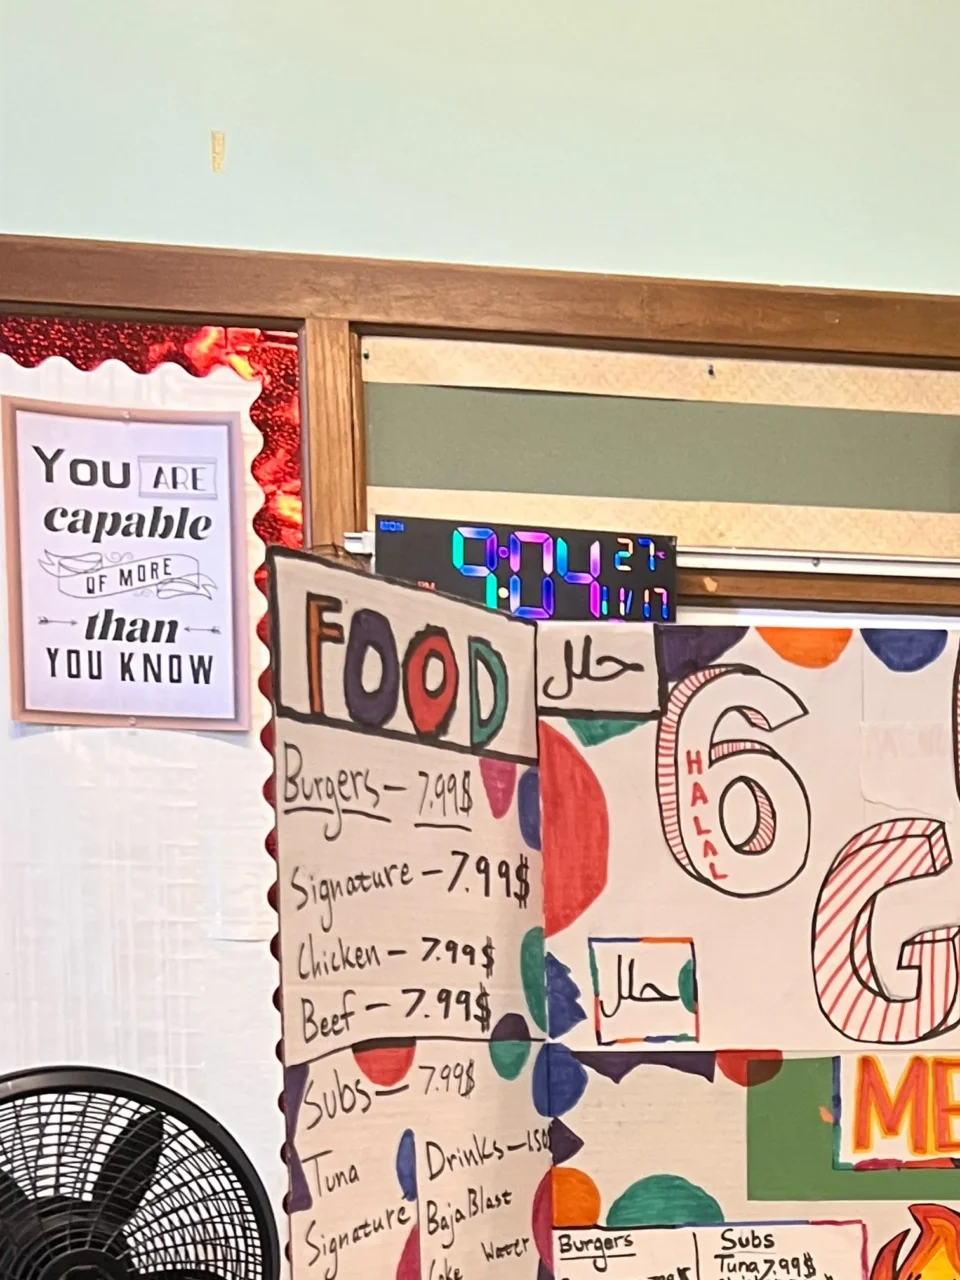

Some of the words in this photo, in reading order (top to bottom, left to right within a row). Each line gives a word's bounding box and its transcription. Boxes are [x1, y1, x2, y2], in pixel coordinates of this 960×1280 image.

[153, 466, 207, 491] ARE
[44, 506, 212, 543] capable
[86, 575, 107, 594] OF
[120, 558, 172, 587] MORE
[452, 527, 601, 618] 9:04
[85, 609, 179, 643] than
[47, 648, 102, 679] YOU
[120, 653, 213, 684] KNOW
[306, 591, 508, 749] FOOD
[284, 742, 380, 841] Burgers
[419, 770, 472, 817] 7.99$
[656, 664, 810, 897] 6
[291, 863, 413, 932] Signature
[448, 850, 530, 908] 7.99$
[298, 934, 381, 979] Chicken
[422, 936, 495, 978] 7.99$
[301, 990, 356, 1043] Beef
[402, 982, 491, 1032] 7.99$
[304, 1069, 371, 1130] Subs
[419, 1059, 475, 1099] 7.99$
[302, 1150, 360, 1196] Tuna
[426, 1134, 504, 1181] Drinks
[468, 1186, 512, 1217] Blast
[559, 1233, 634, 1272] Burgers
[721, 1229, 775, 1250] Subs
[715, 1254, 759, 1273] Tuna
